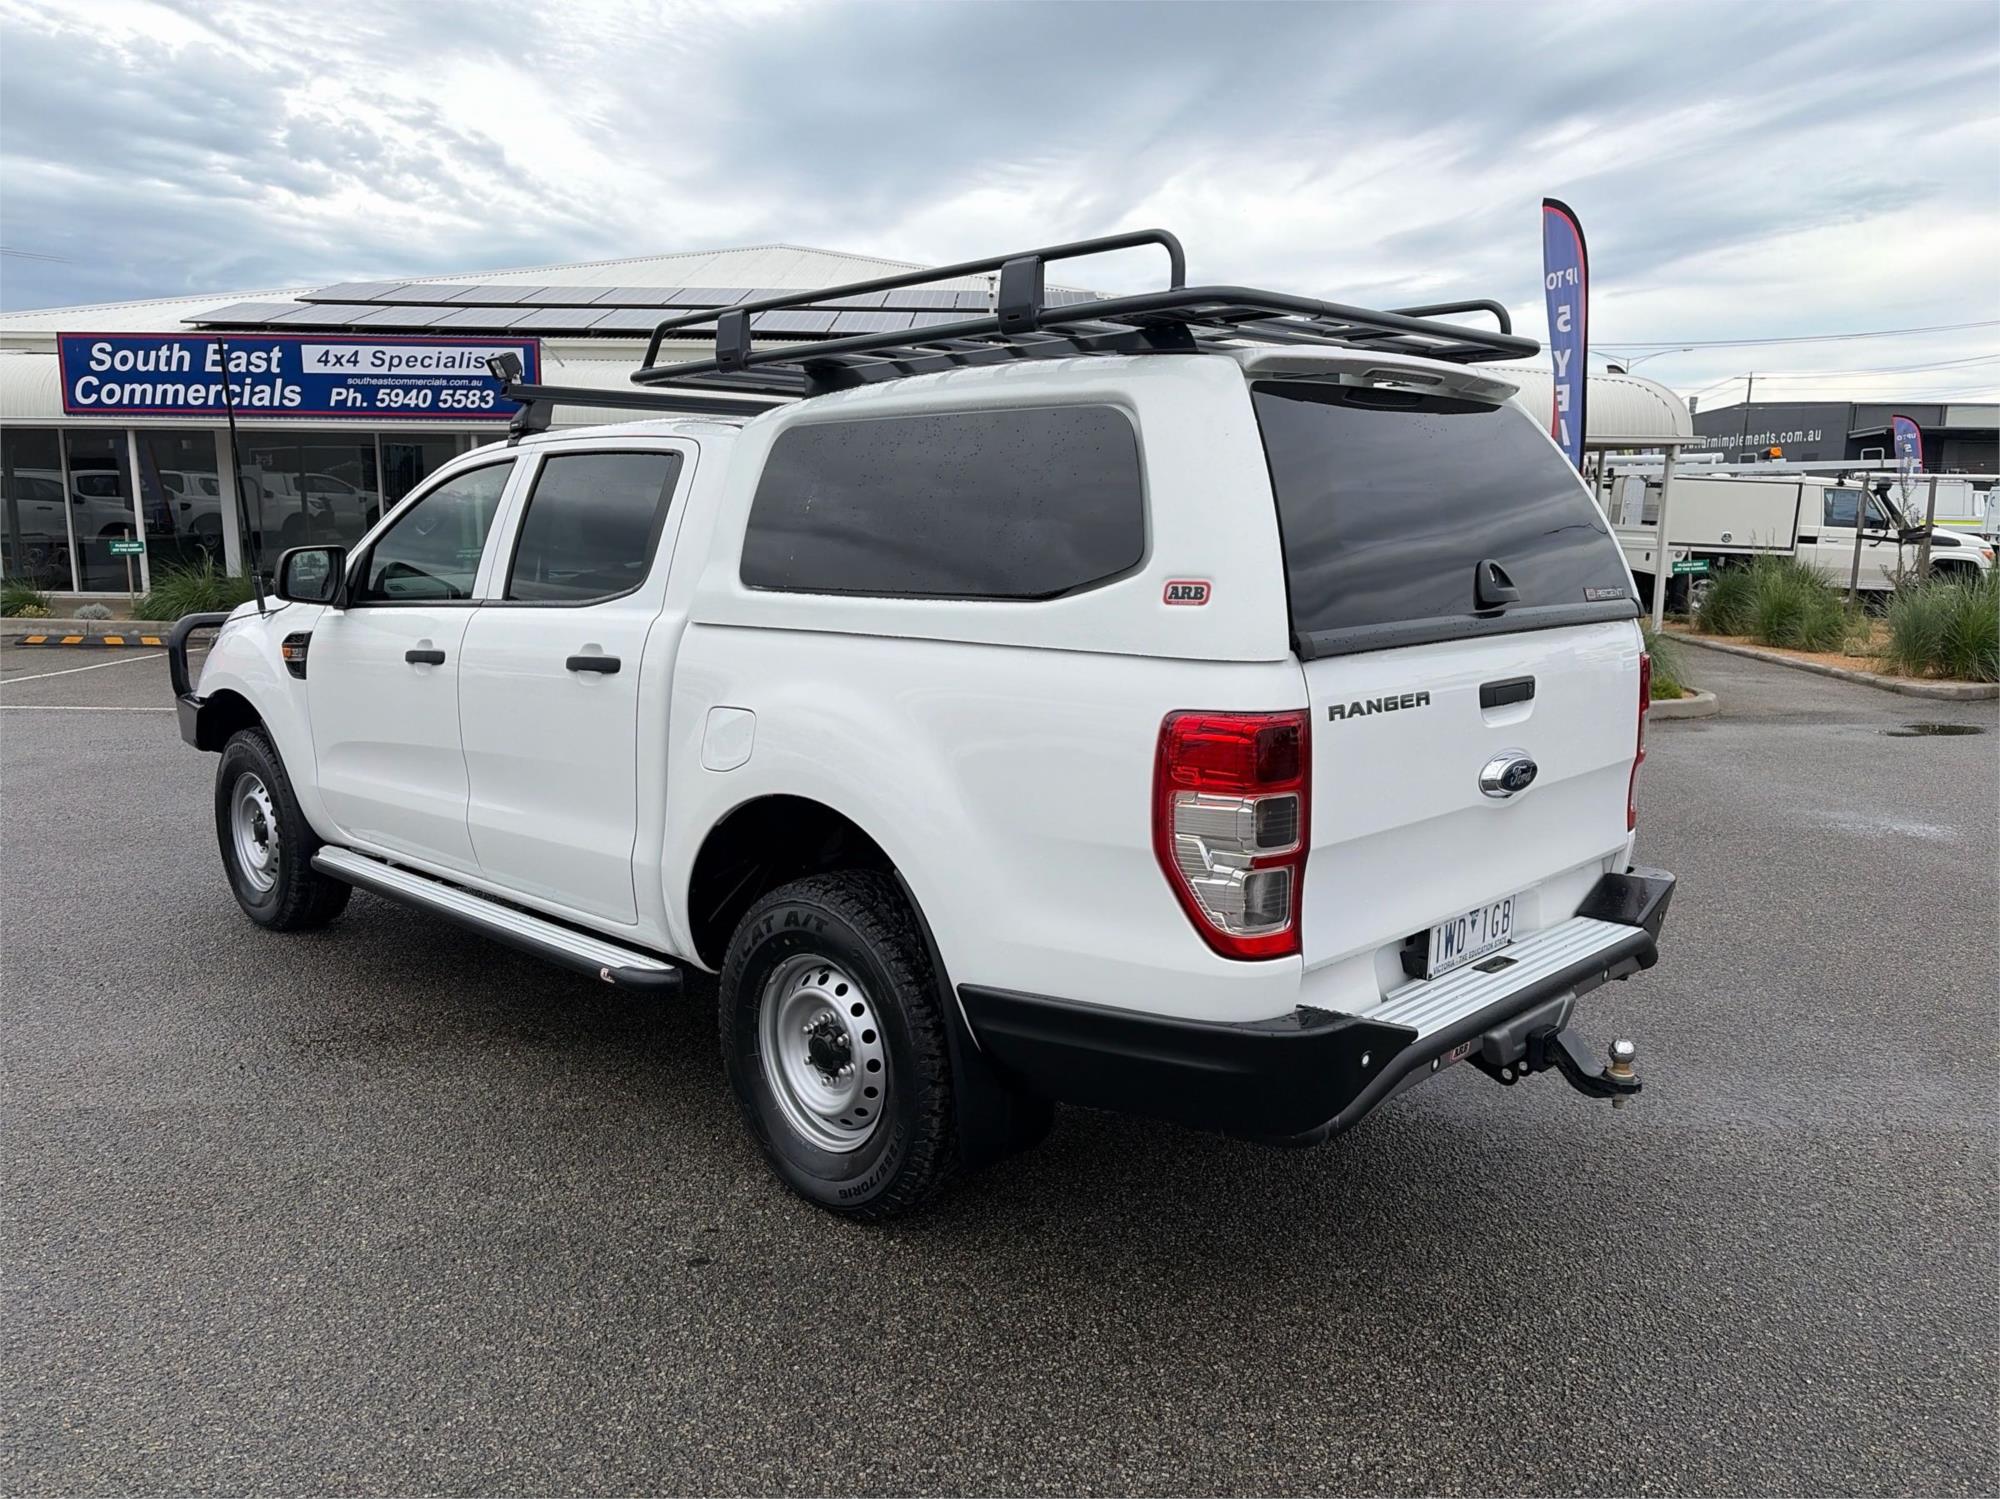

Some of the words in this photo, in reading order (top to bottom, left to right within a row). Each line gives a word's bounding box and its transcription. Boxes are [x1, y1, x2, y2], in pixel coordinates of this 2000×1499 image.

[89, 342, 191, 372] South
[204, 343, 283, 373] East
[316, 349, 360, 368] 4x4
[370, 349, 495, 373] Specialis
[74, 375, 302, 407] Commercials
[347, 376, 483, 387] southeastcommercials.com.au
[329, 387, 368, 407] Ph.
[375, 388, 432, 408] 5940
[438, 389, 495, 409] 5583
[1168, 585, 1205, 600] ARB
[1328, 690, 1431, 722] RANGER
[1510, 765, 1534, 786] Ford
[1436, 917, 1466, 963] 1WD
[1482, 899, 1511, 943] 1GB
